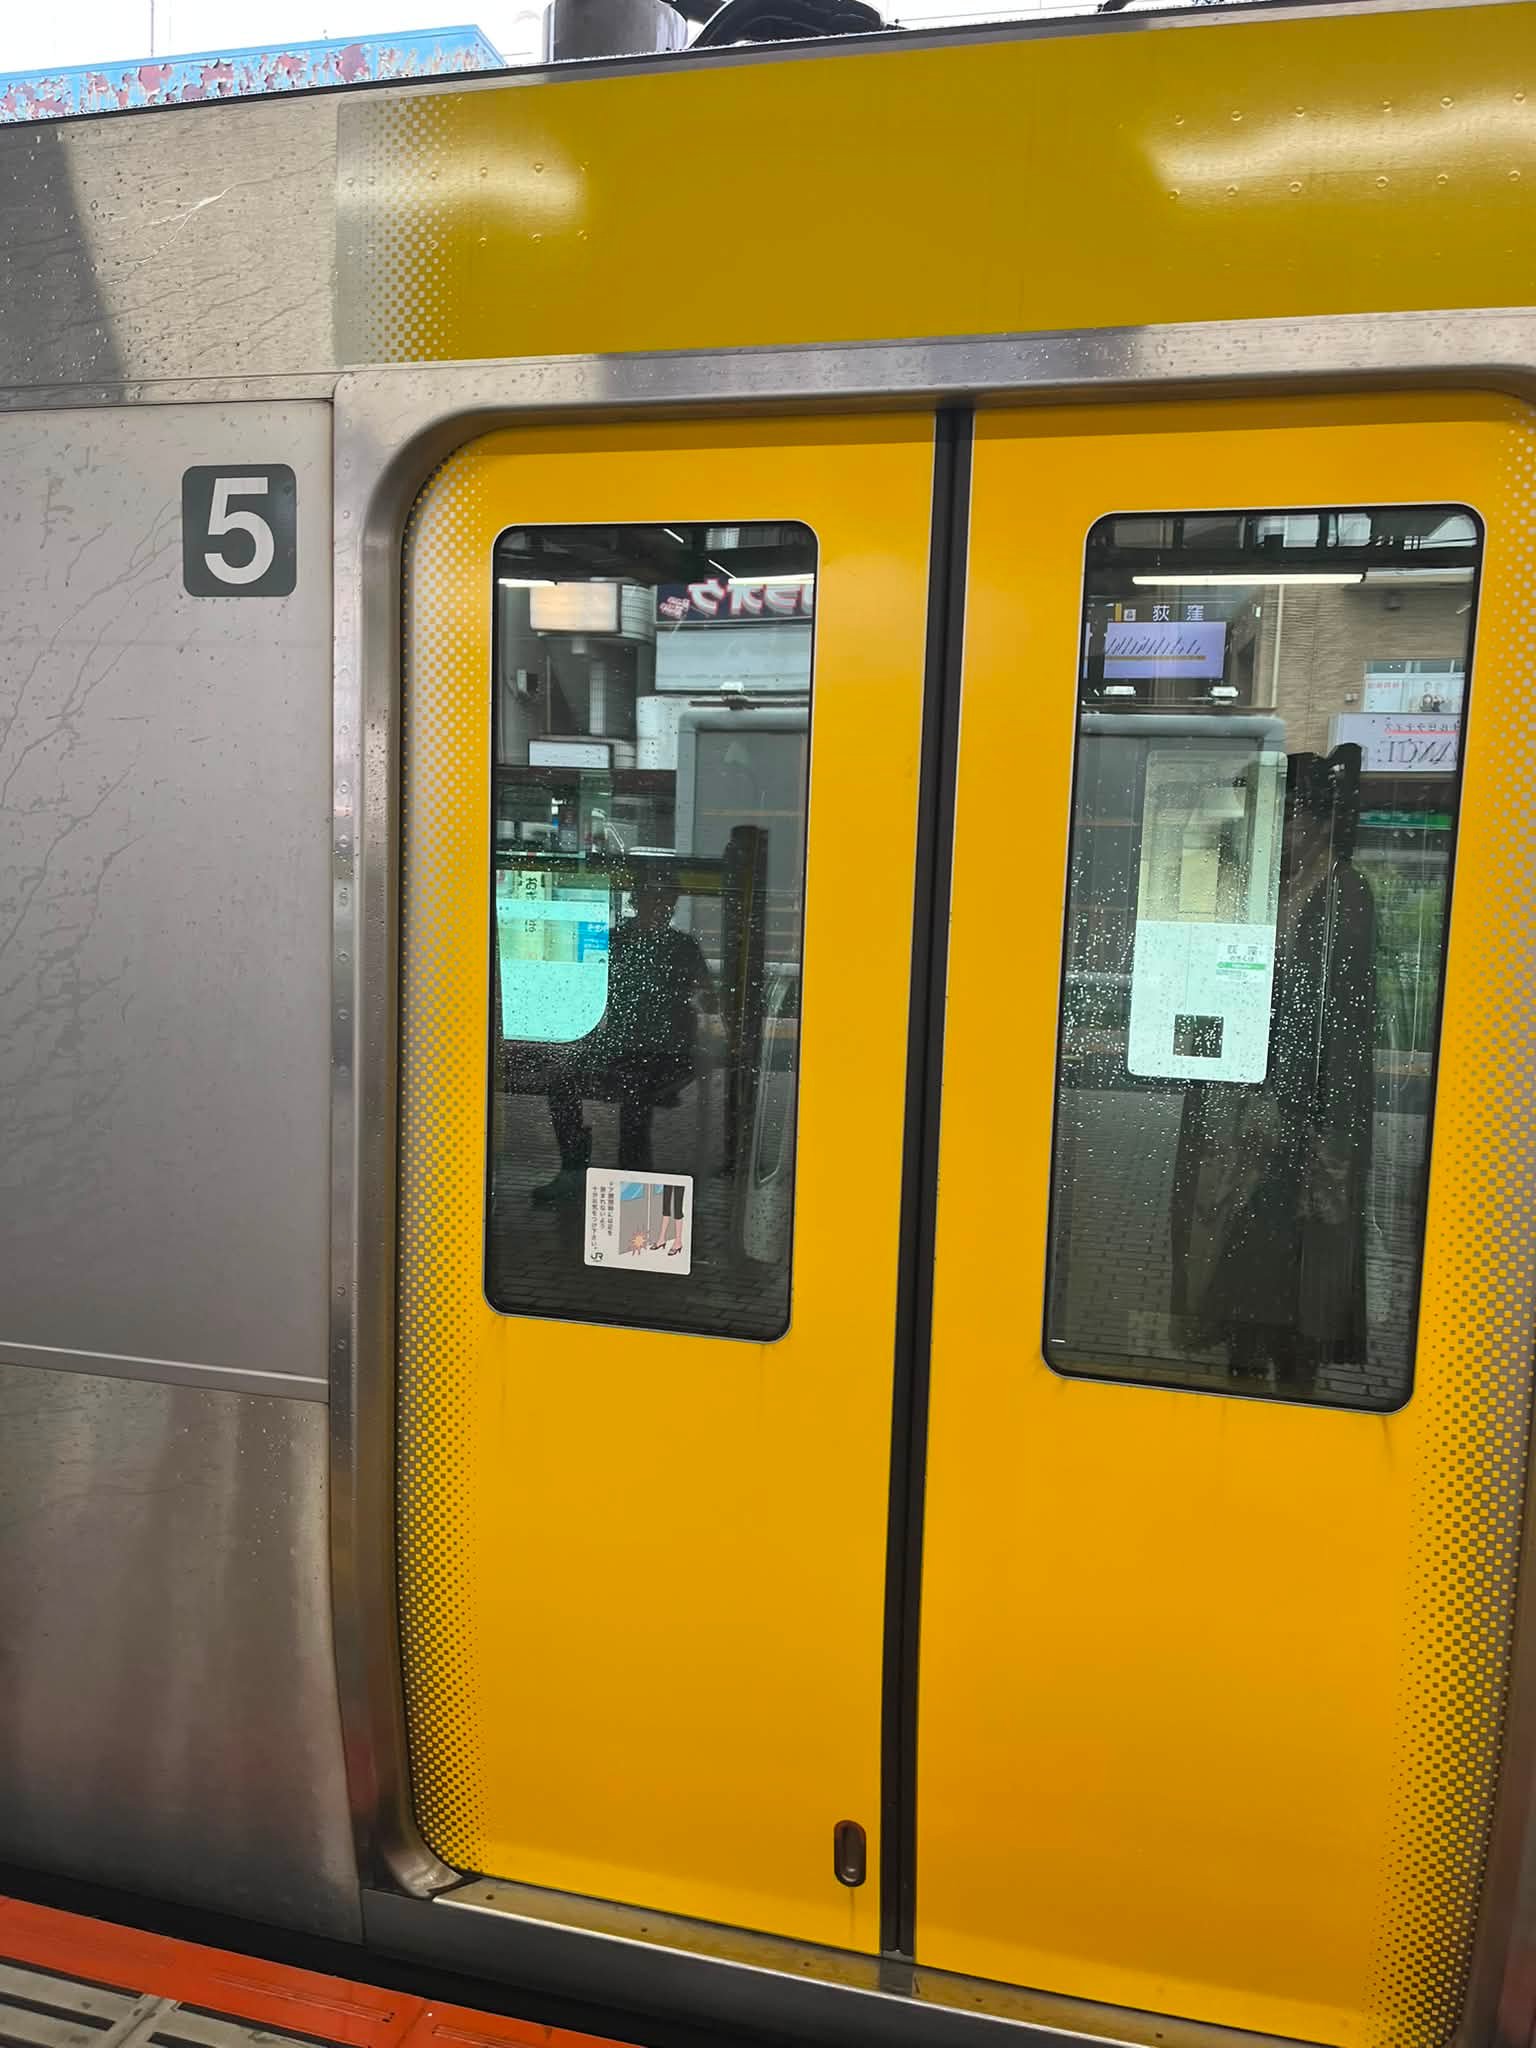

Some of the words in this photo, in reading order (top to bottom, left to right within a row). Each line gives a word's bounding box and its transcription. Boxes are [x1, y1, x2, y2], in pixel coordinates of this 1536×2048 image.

[204, 476, 275, 585] 5
[1152, 604, 1204, 622] 荻窪
[590, 1252, 604, 1260] JR
